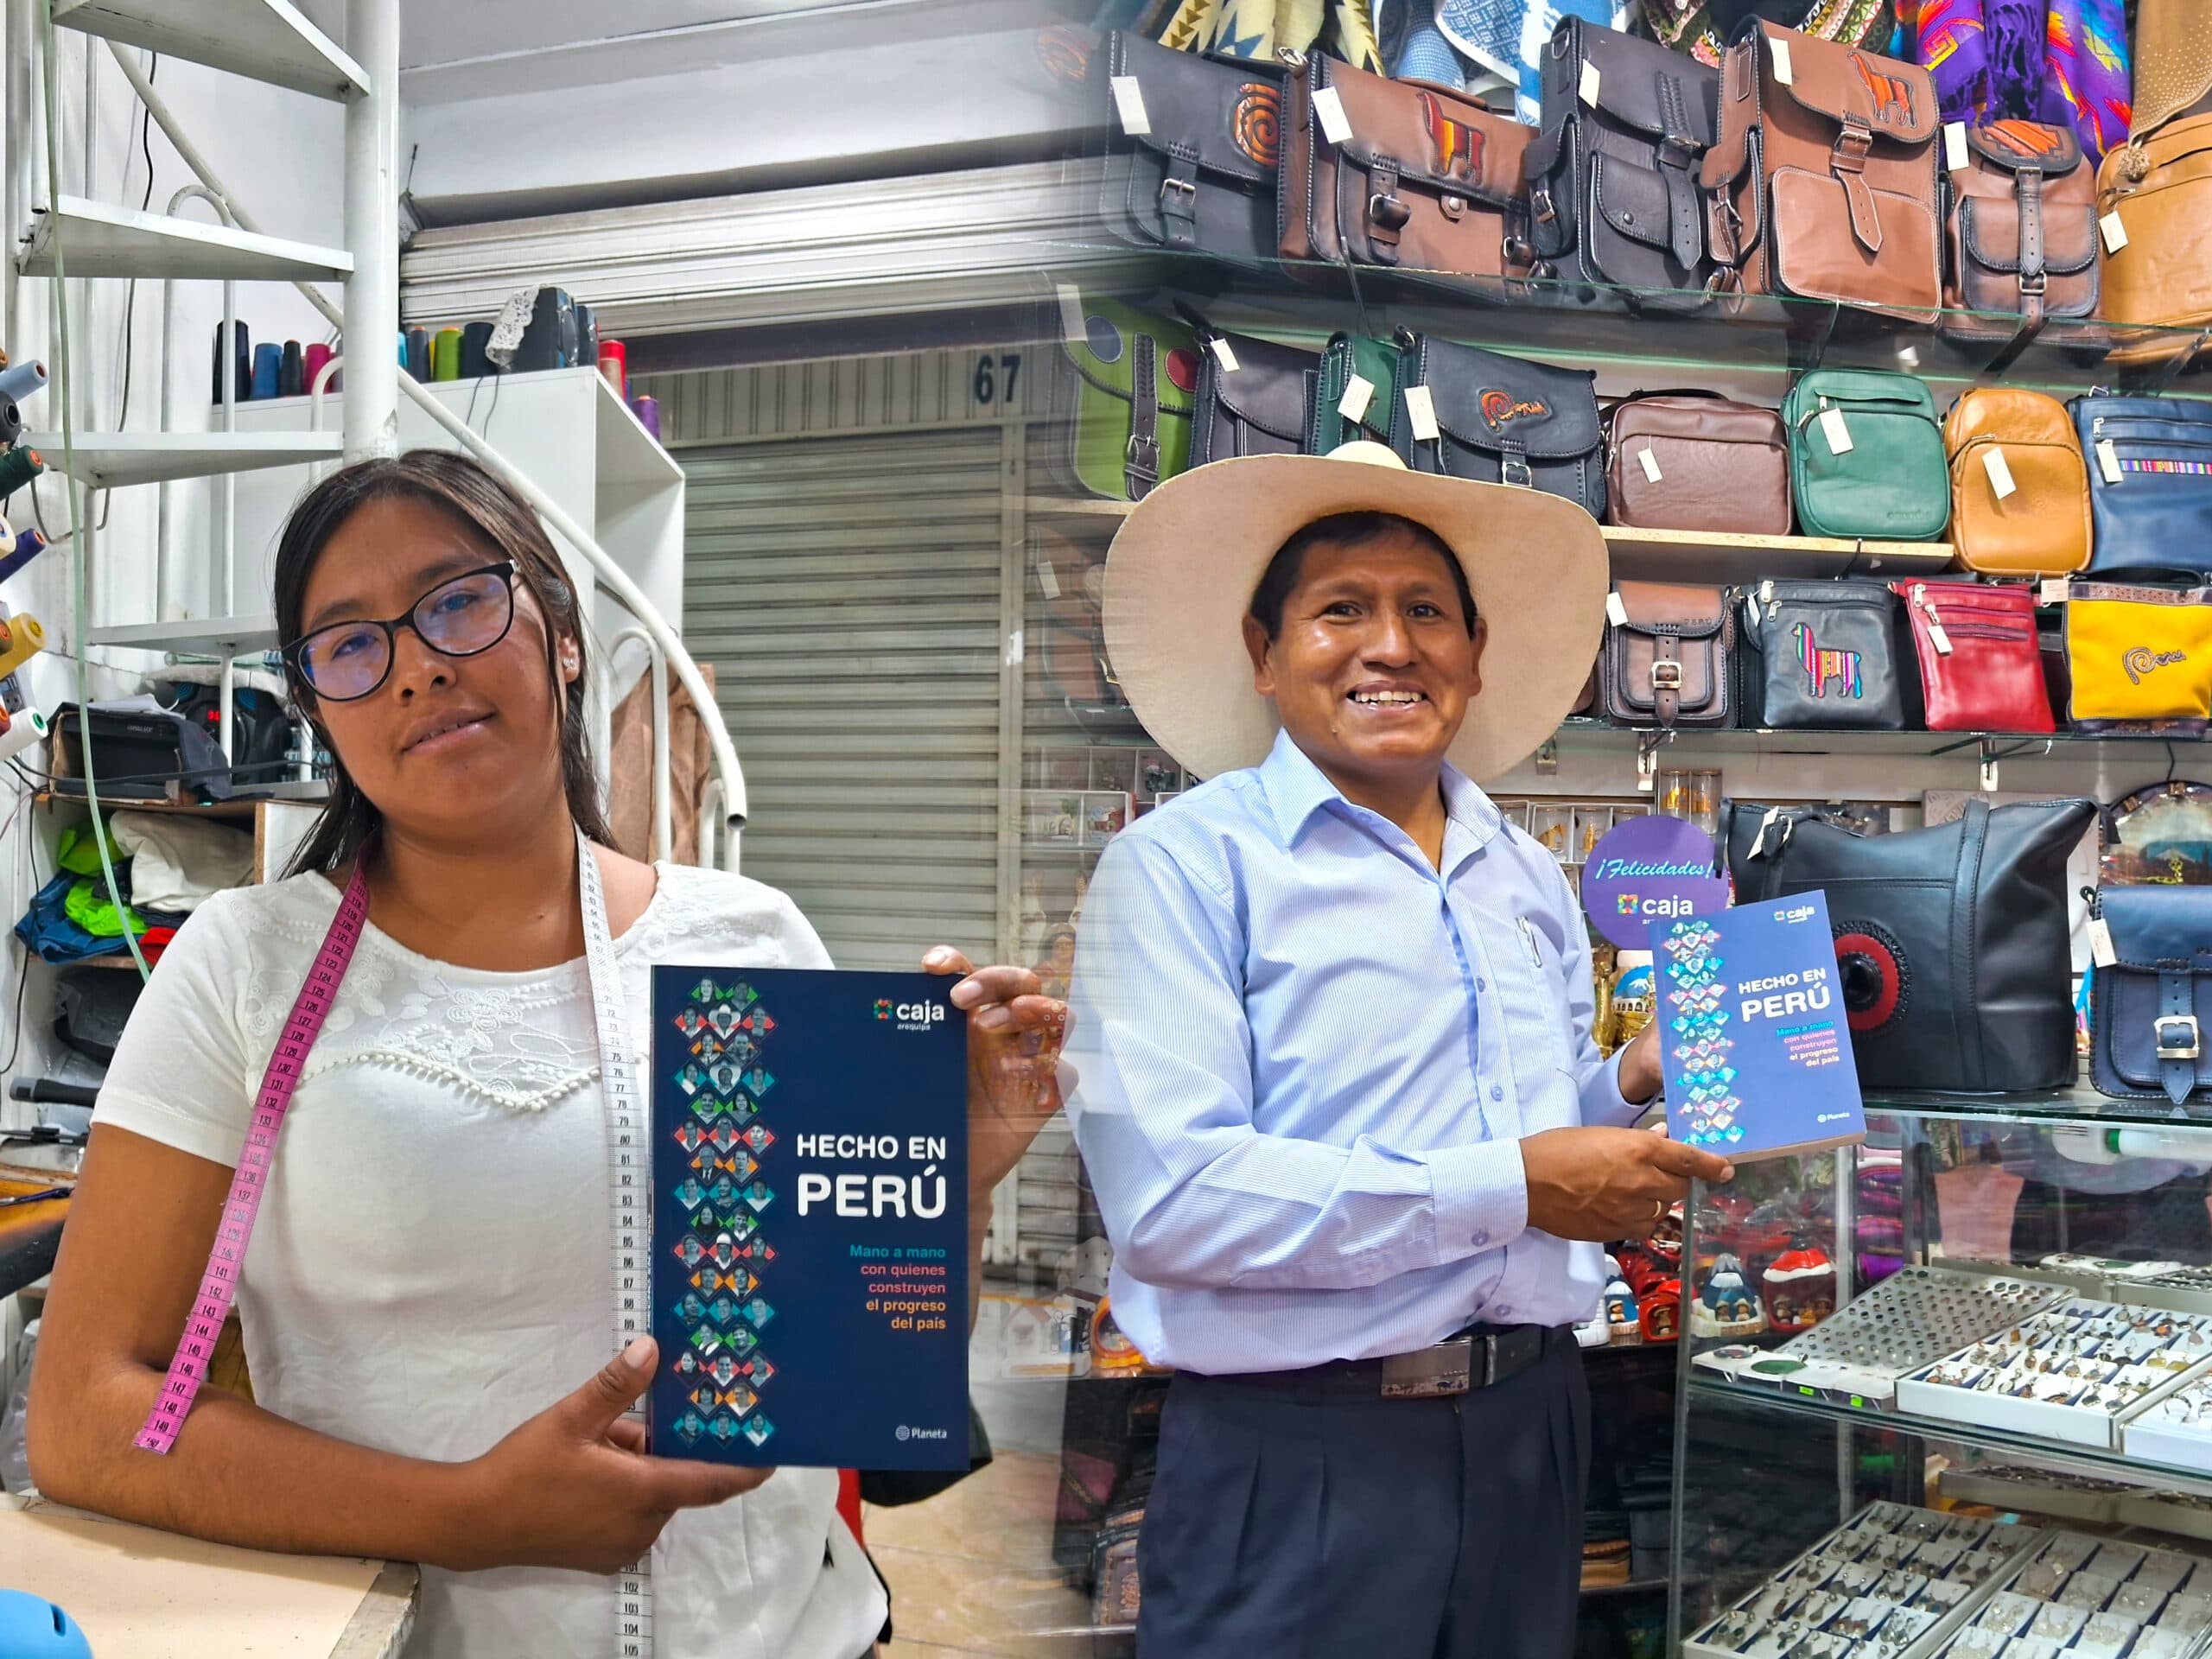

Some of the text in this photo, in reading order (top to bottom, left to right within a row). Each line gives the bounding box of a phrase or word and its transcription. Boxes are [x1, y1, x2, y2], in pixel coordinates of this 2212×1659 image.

[976, 354, 1020, 404] 67
[1595, 858, 1713, 879] ¡Felicidades!
[1642, 894, 1694, 918] caja
[1786, 906, 1815, 920] caja
[341, 920, 353, 931] 120
[337, 932, 347, 944] 121
[331, 944, 343, 956] 122
[325, 957, 338, 969] 123
[319, 971, 332, 982] 124
[1738, 967, 1827, 995] HECHO EN
[312, 986, 325, 997] 125
[305, 1001, 318, 1013] 126
[1741, 982, 1831, 1023] PERÚ
[896, 999, 944, 1024] caja
[298, 1016, 311, 1027] 127
[1777, 1027, 1800, 1036] Mano
[1809, 1021, 1834, 1030] mano
[291, 1031, 304, 1042] 128
[1802, 1029, 1835, 1041] quienes
[1789, 1039, 1837, 1052] construyen
[284, 1046, 298, 1058] 129
[612, 1052, 621, 1061] 75
[1800, 1047, 1839, 1059] progreso
[277, 1063, 291, 1073] 130
[613, 1068, 623, 1077] 76
[271, 1079, 283, 1090] 131
[265, 1096, 278, 1109] 132
[617, 1100, 627, 1109] 78
[260, 1115, 272, 1126] 133
[619, 1116, 629, 1127] 79
[620, 1135, 631, 1145] 80
[797, 1133, 946, 1160] HECHO EN
[621, 1154, 630, 1165] 81
[622, 1175, 632, 1185] 82
[238, 1190, 251, 1201] 137
[798, 1164, 946, 1219] PERÚ
[622, 1194, 632, 1206] 83
[623, 1216, 632, 1226] 84
[849, 1243, 946, 1258] Mano a mano
[624, 1257, 633, 1268] 86
[215, 1266, 228, 1278] 141
[861, 1262, 946, 1278] con quienes
[624, 1278, 633, 1288] 87
[868, 1281, 945, 1296] construyen
[209, 1286, 223, 1298] 142
[624, 1298, 634, 1309] 88
[866, 1298, 946, 1314] el progreso
[202, 1305, 216, 1318] 143
[624, 1319, 634, 1330] 89
[891, 1316, 946, 1332] del país
[195, 1324, 209, 1337] 144
[172, 1382, 186, 1395] 147
[163, 1401, 178, 1414] 148
[155, 1420, 169, 1433] 149
[912, 1427, 948, 1440] Planeta
[625, 1581, 639, 1592] 102
[625, 1603, 639, 1614] 103
[625, 1624, 639, 1635] 104
